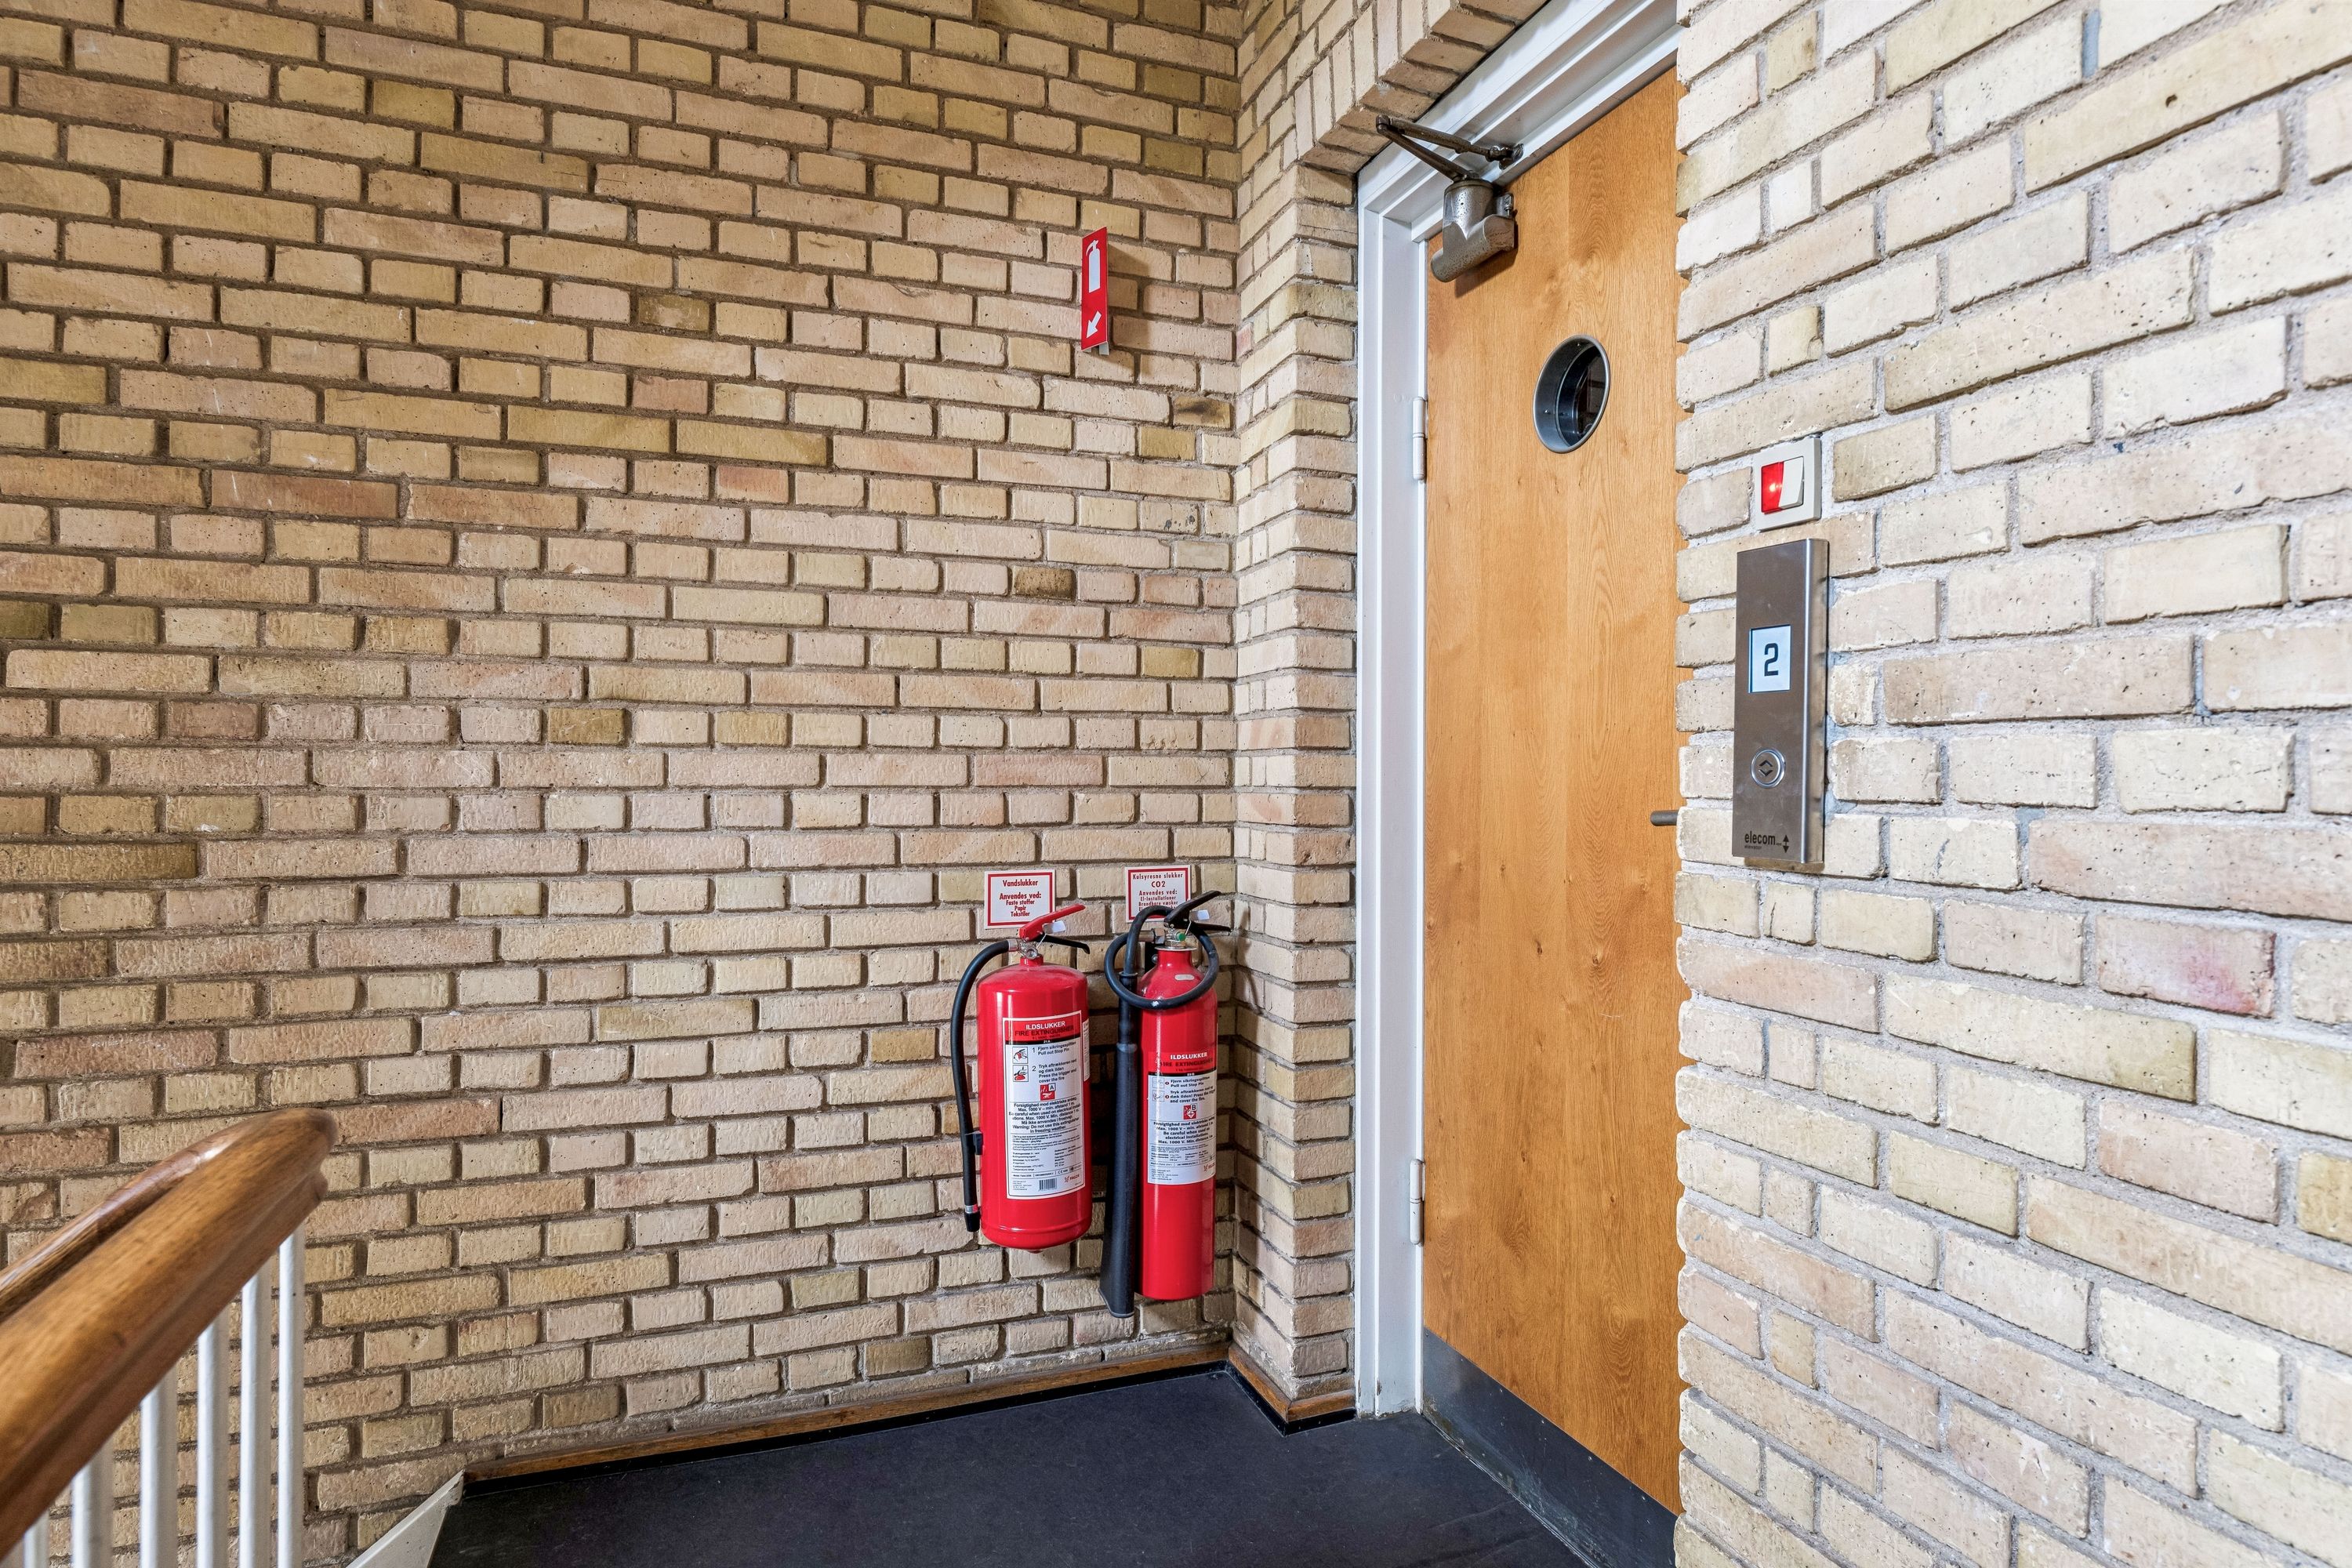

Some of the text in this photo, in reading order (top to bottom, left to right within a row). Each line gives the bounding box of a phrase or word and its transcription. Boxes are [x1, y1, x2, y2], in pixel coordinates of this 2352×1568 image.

[1764, 643, 1779, 677] 2
[1744, 831, 1776, 845] elecom
[1026, 1021, 1066, 1030] ILDSLUKKER
